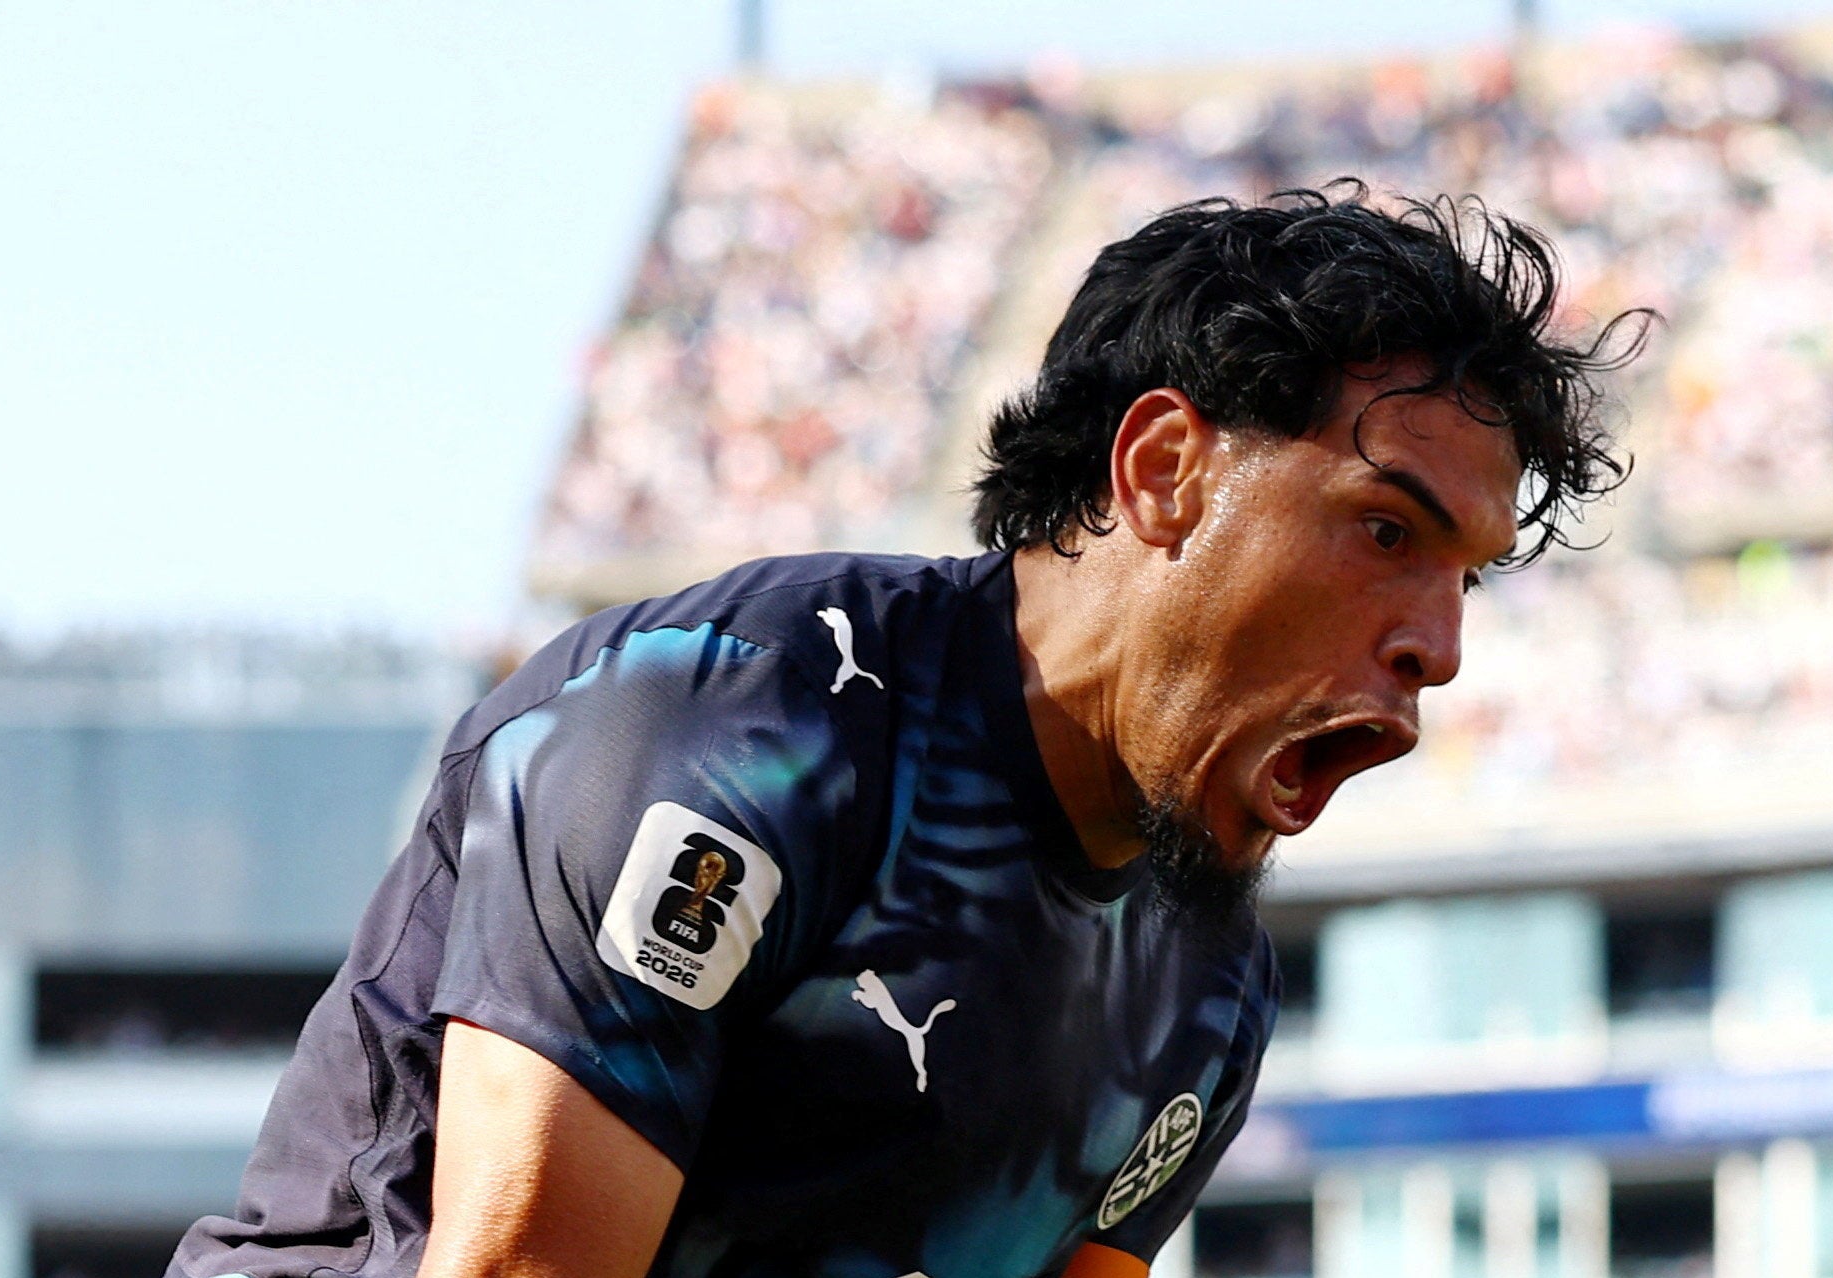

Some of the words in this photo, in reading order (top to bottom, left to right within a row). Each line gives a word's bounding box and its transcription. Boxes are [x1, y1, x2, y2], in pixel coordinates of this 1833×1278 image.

[668, 919, 700, 943] FIFA
[635, 949, 698, 989] 2026
[642, 936, 682, 962] WORLD
[682, 956, 705, 972] CUP
